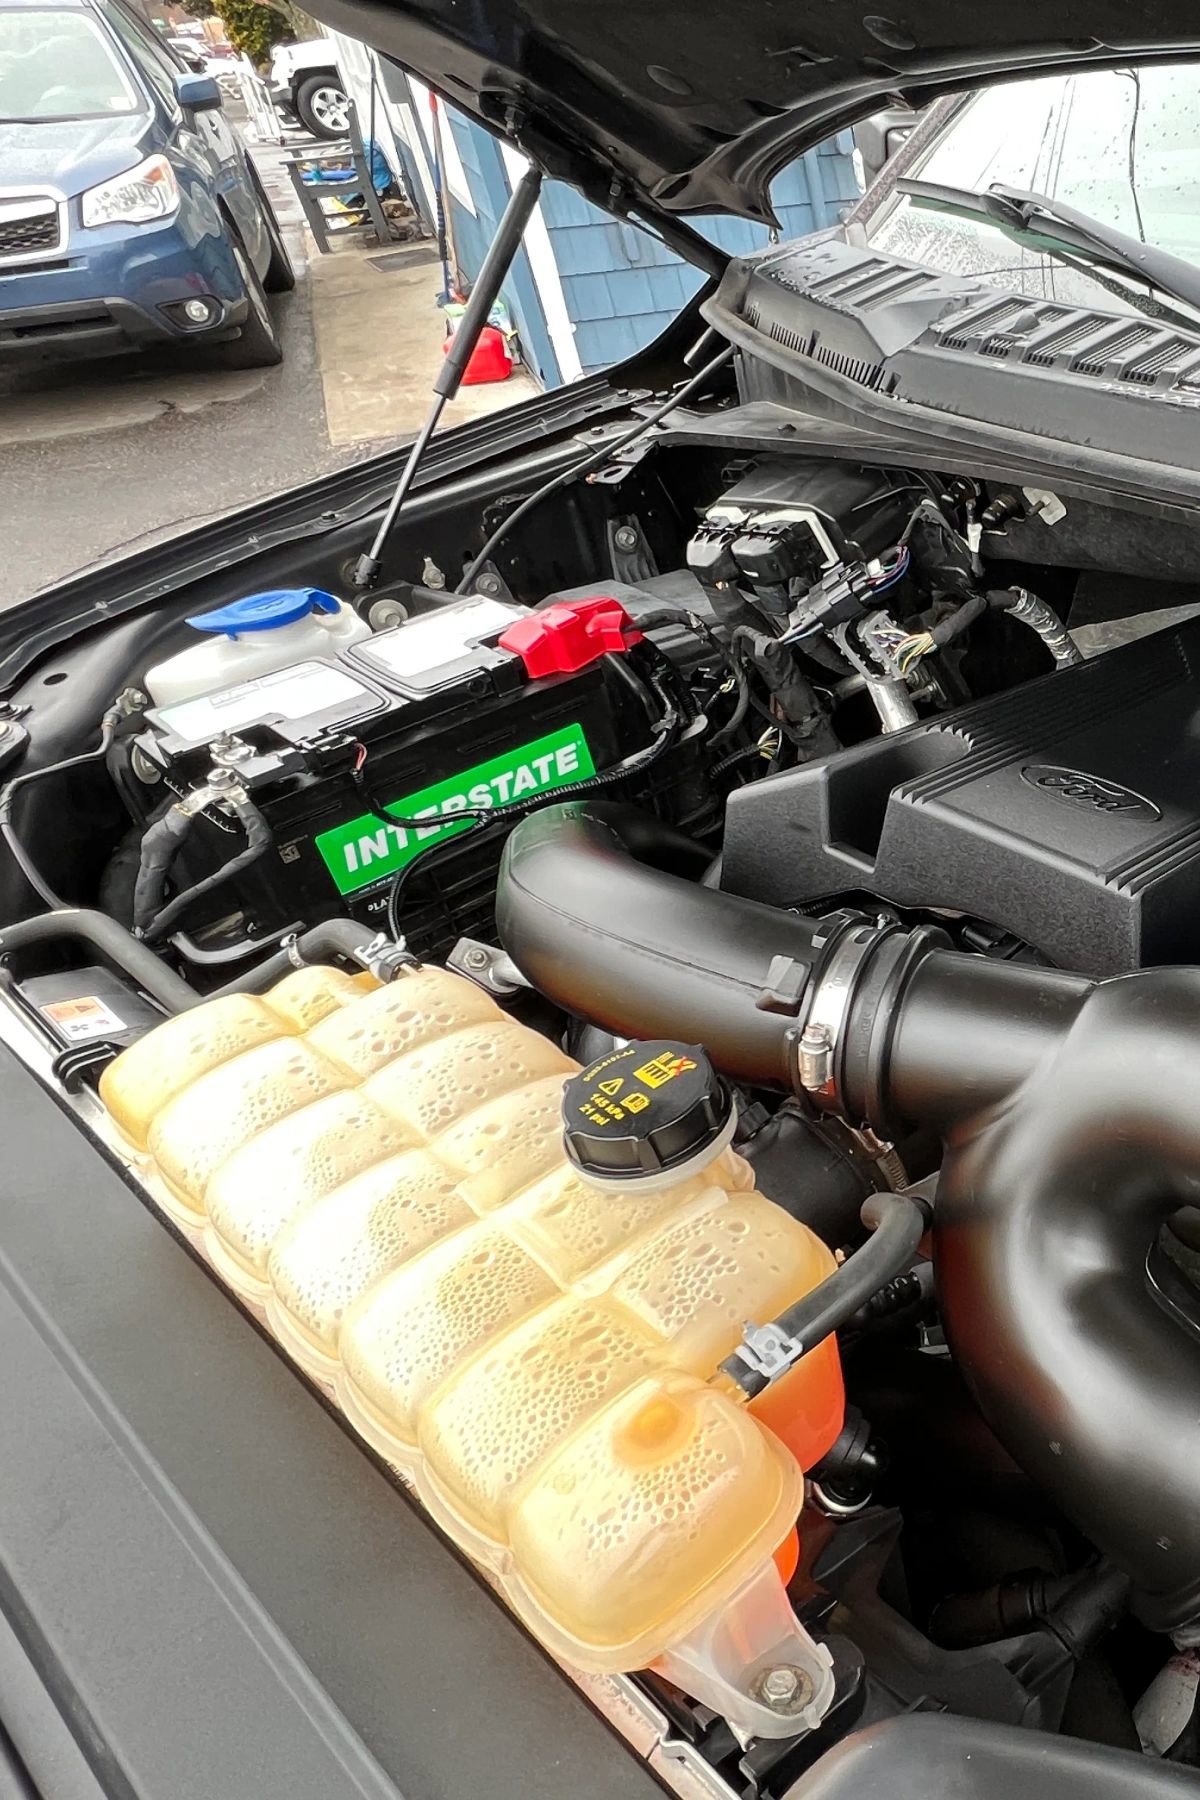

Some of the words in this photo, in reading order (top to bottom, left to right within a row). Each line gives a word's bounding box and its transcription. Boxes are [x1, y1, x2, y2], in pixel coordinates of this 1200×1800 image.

[343, 743, 579, 873] INTERSTATE
[1036, 773, 1142, 814] Ford
[579, 1103, 596, 1115] 21
[589, 1113, 611, 1126] psi
[590, 1093, 610, 1108] 145
[604, 1103, 625, 1120] kPa
